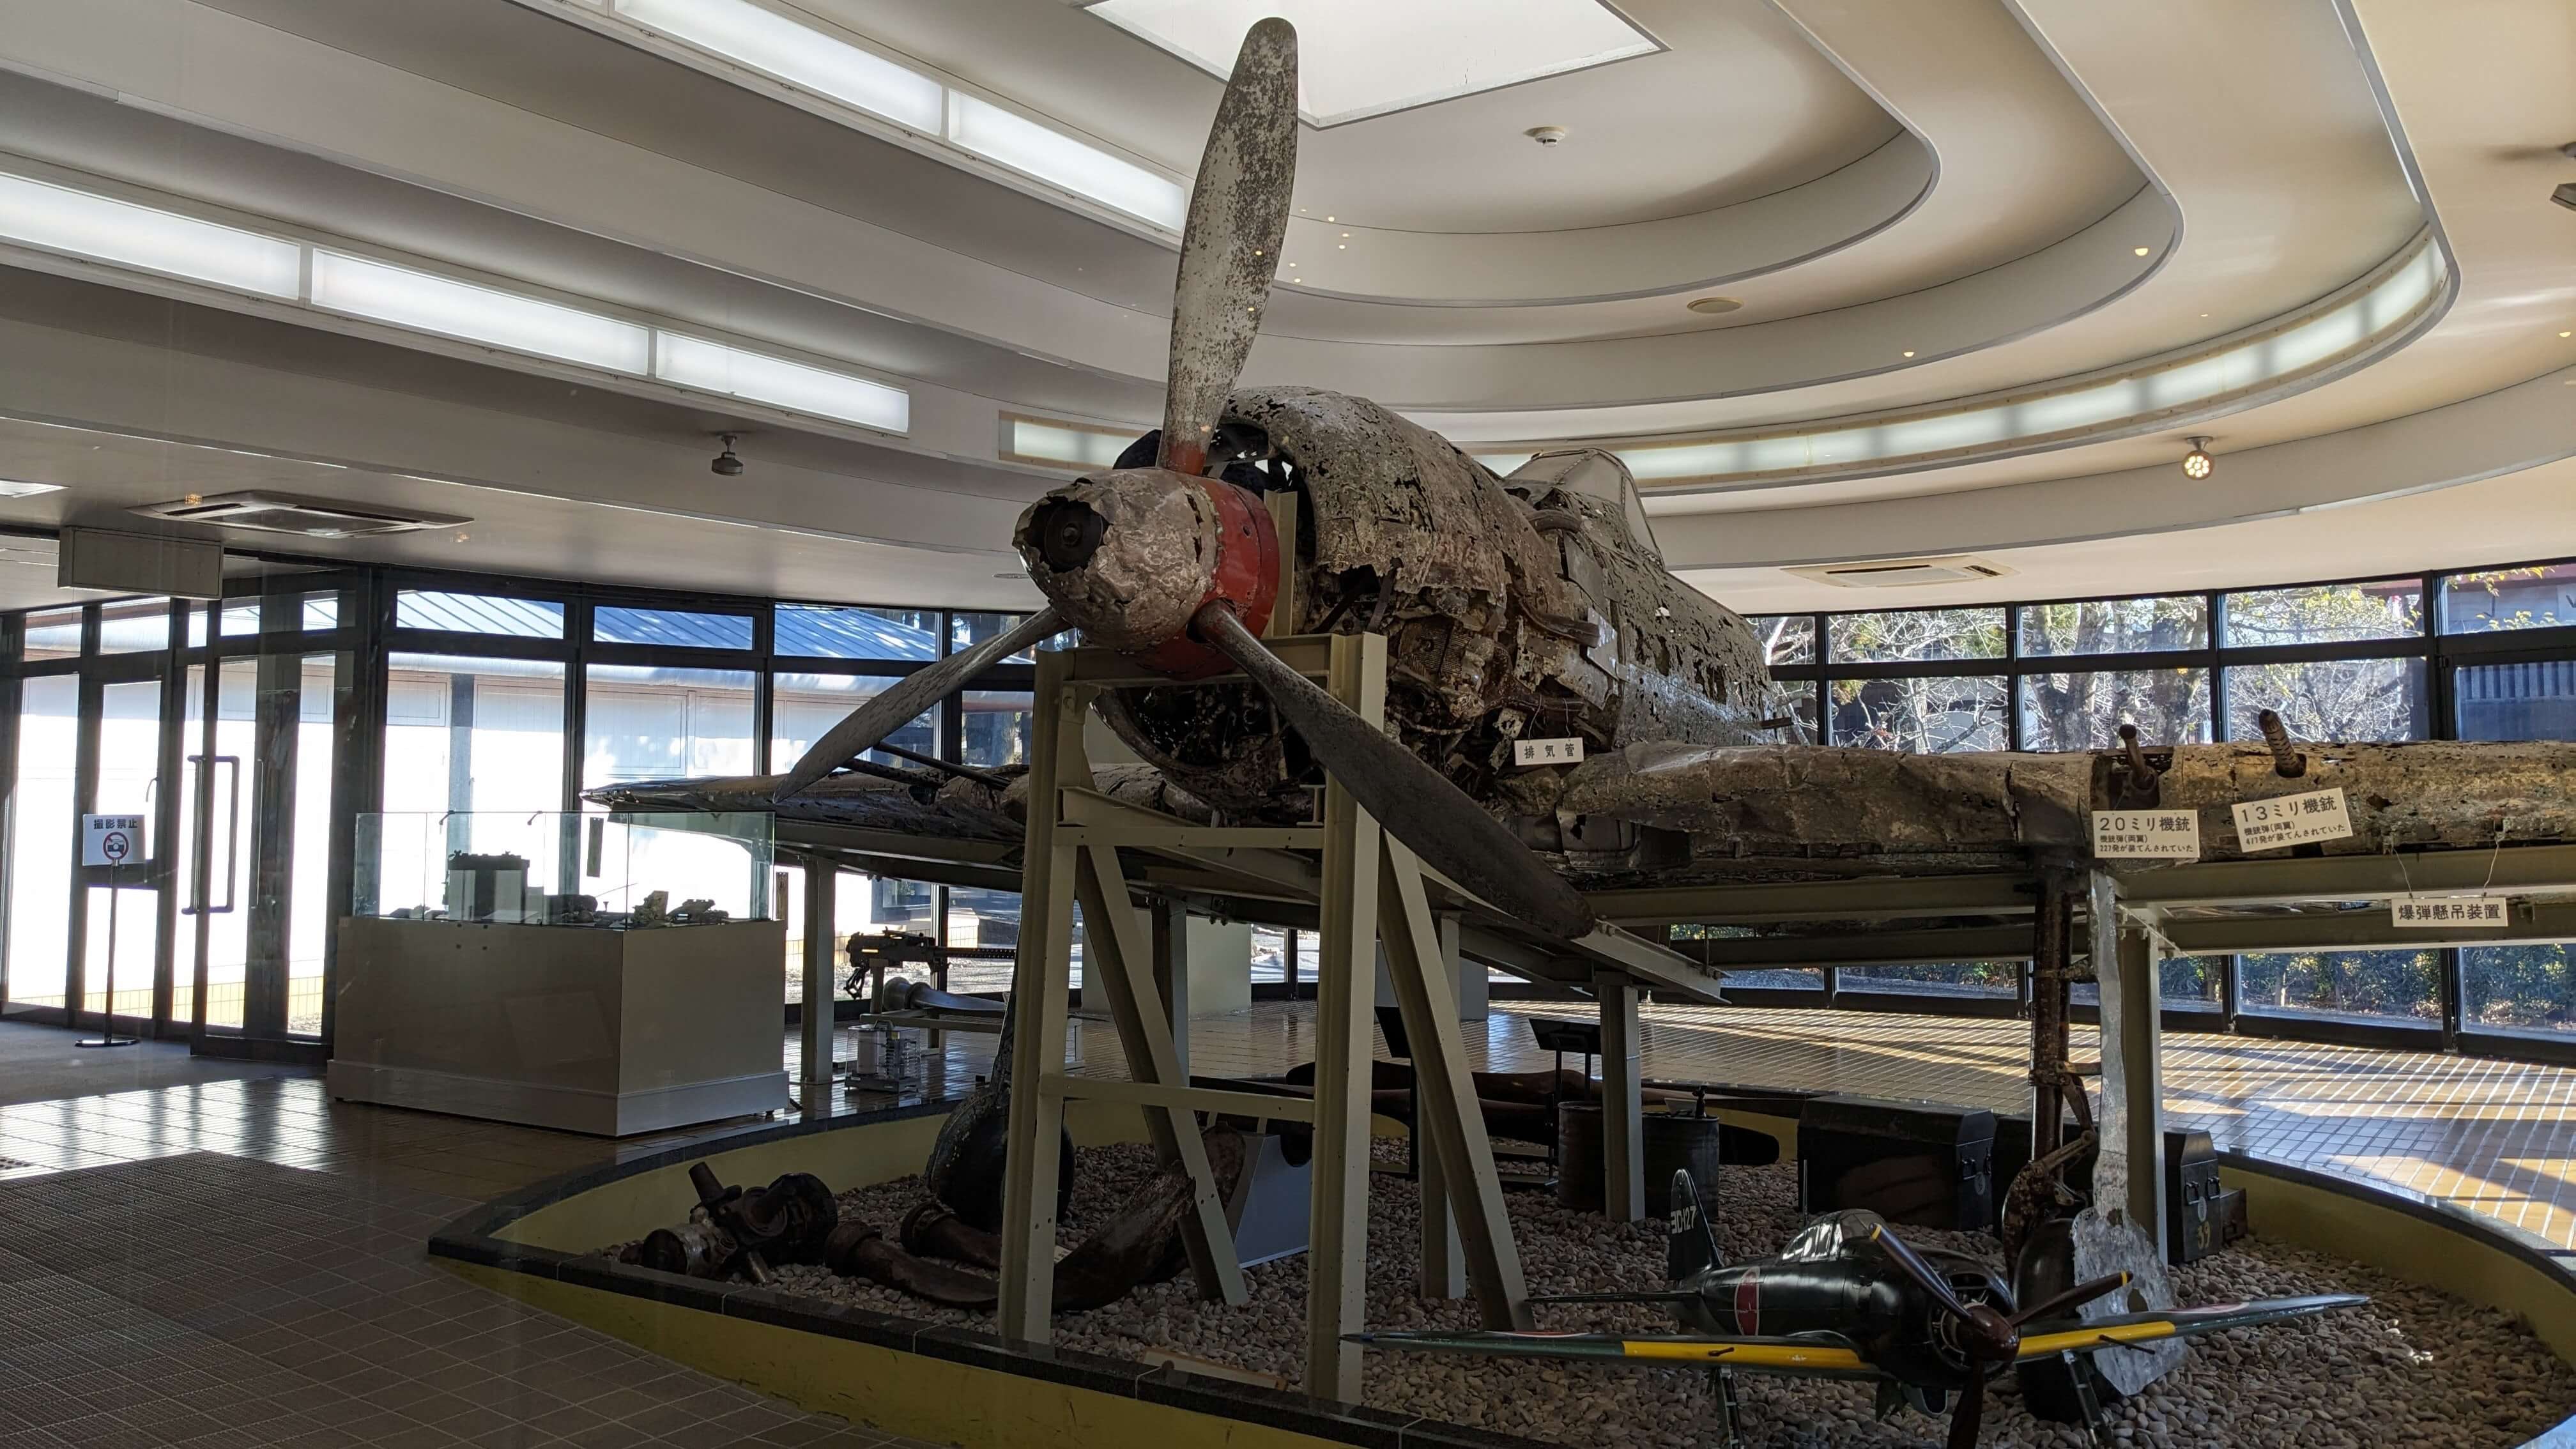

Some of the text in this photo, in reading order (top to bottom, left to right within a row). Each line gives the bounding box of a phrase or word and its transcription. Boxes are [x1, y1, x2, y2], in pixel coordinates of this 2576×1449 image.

[1524, 743, 1574, 759] 排気管
[2241, 795, 2338, 822] 13ミリ機銃
[93, 818, 138, 829] 撮影禁止
[2099, 816, 2191, 831] 20ミリ機銃
[2398, 904, 2501, 920] 爆弾懸吊装置
